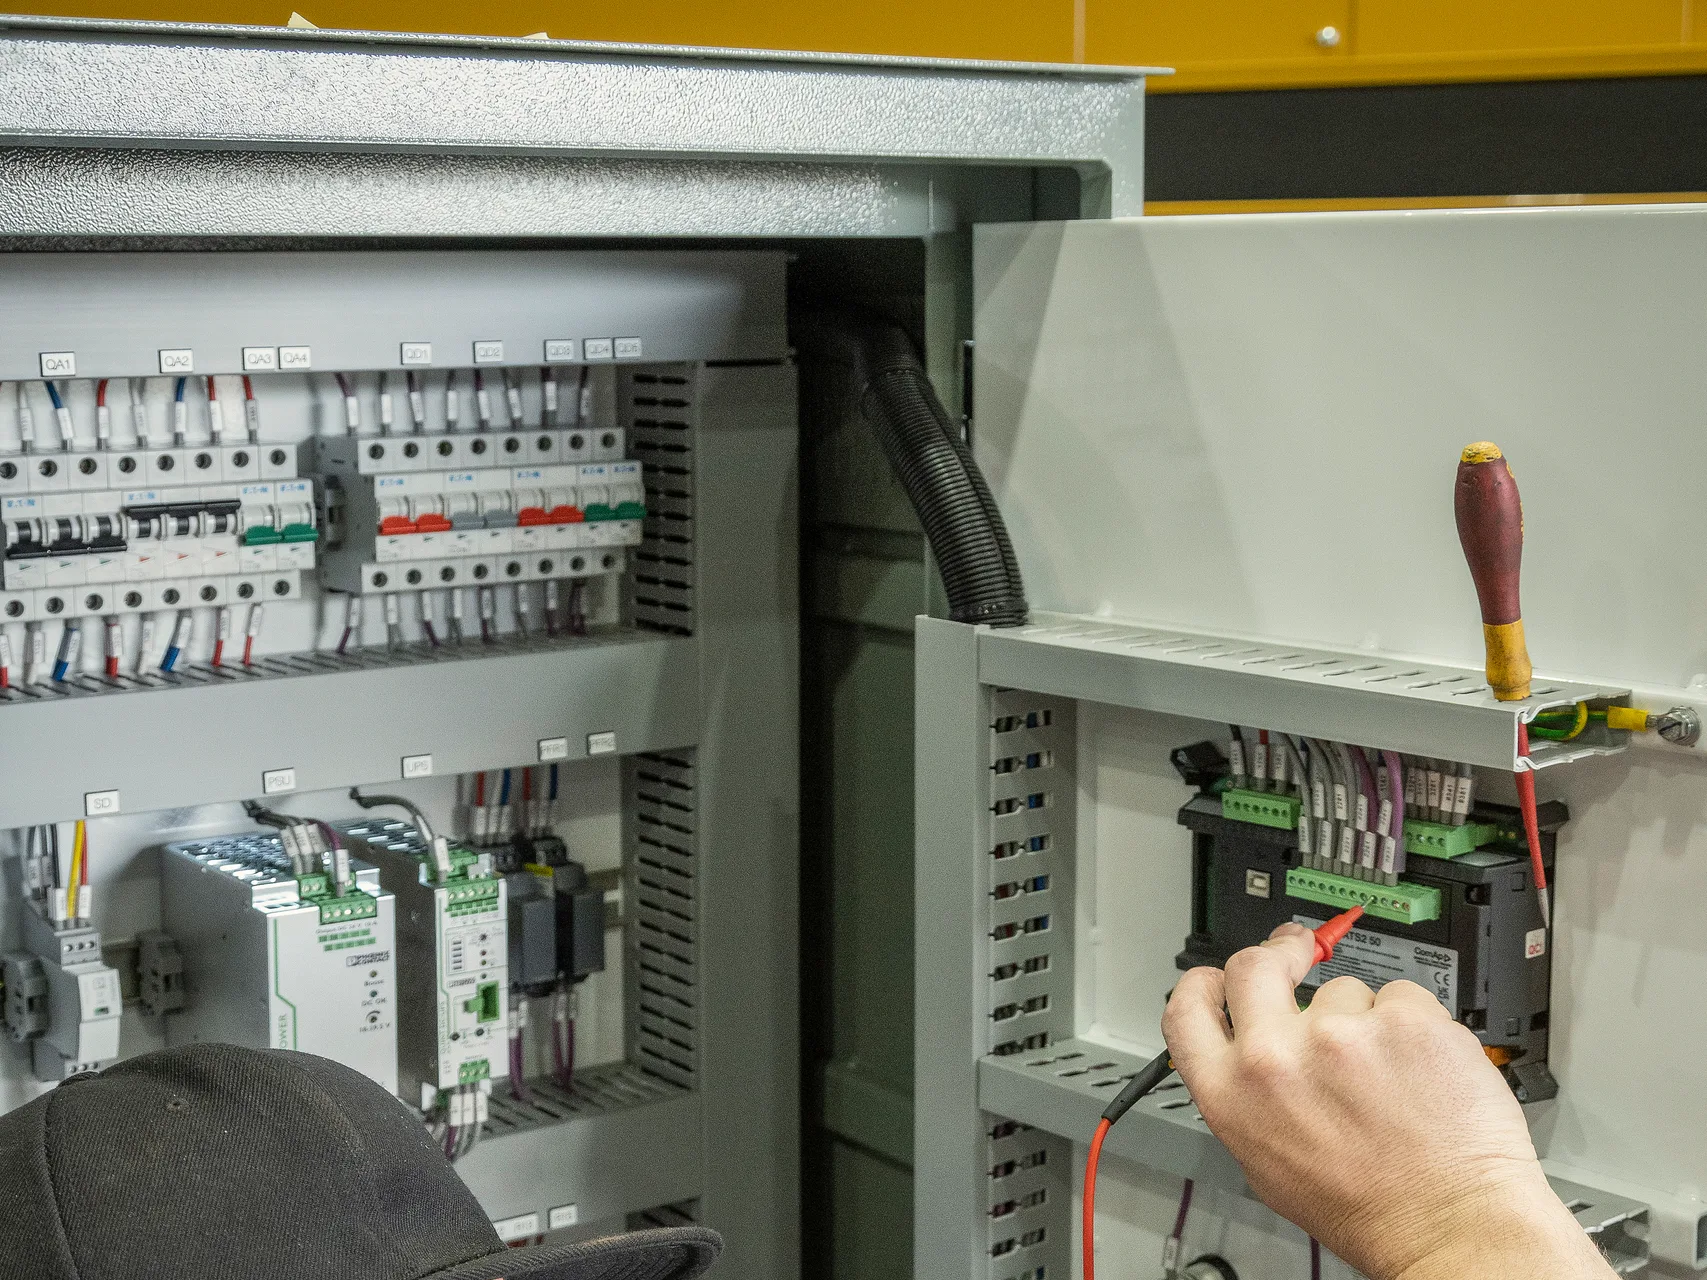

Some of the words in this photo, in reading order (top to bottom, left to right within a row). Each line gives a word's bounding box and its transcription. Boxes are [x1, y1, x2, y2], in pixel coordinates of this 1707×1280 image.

[283, 352, 308, 364] QA4
[406, 348, 428, 360] QD1
[479, 346, 500, 358] QD2
[45, 358, 72, 371] QA1
[164, 355, 190, 367] QA2
[247, 352, 272, 365] QA3
[267, 773, 291, 788] PSU
[93, 797, 112, 809] SD
[1369, 934, 1382, 947] 50
[1414, 946, 1445, 961] ComAp
